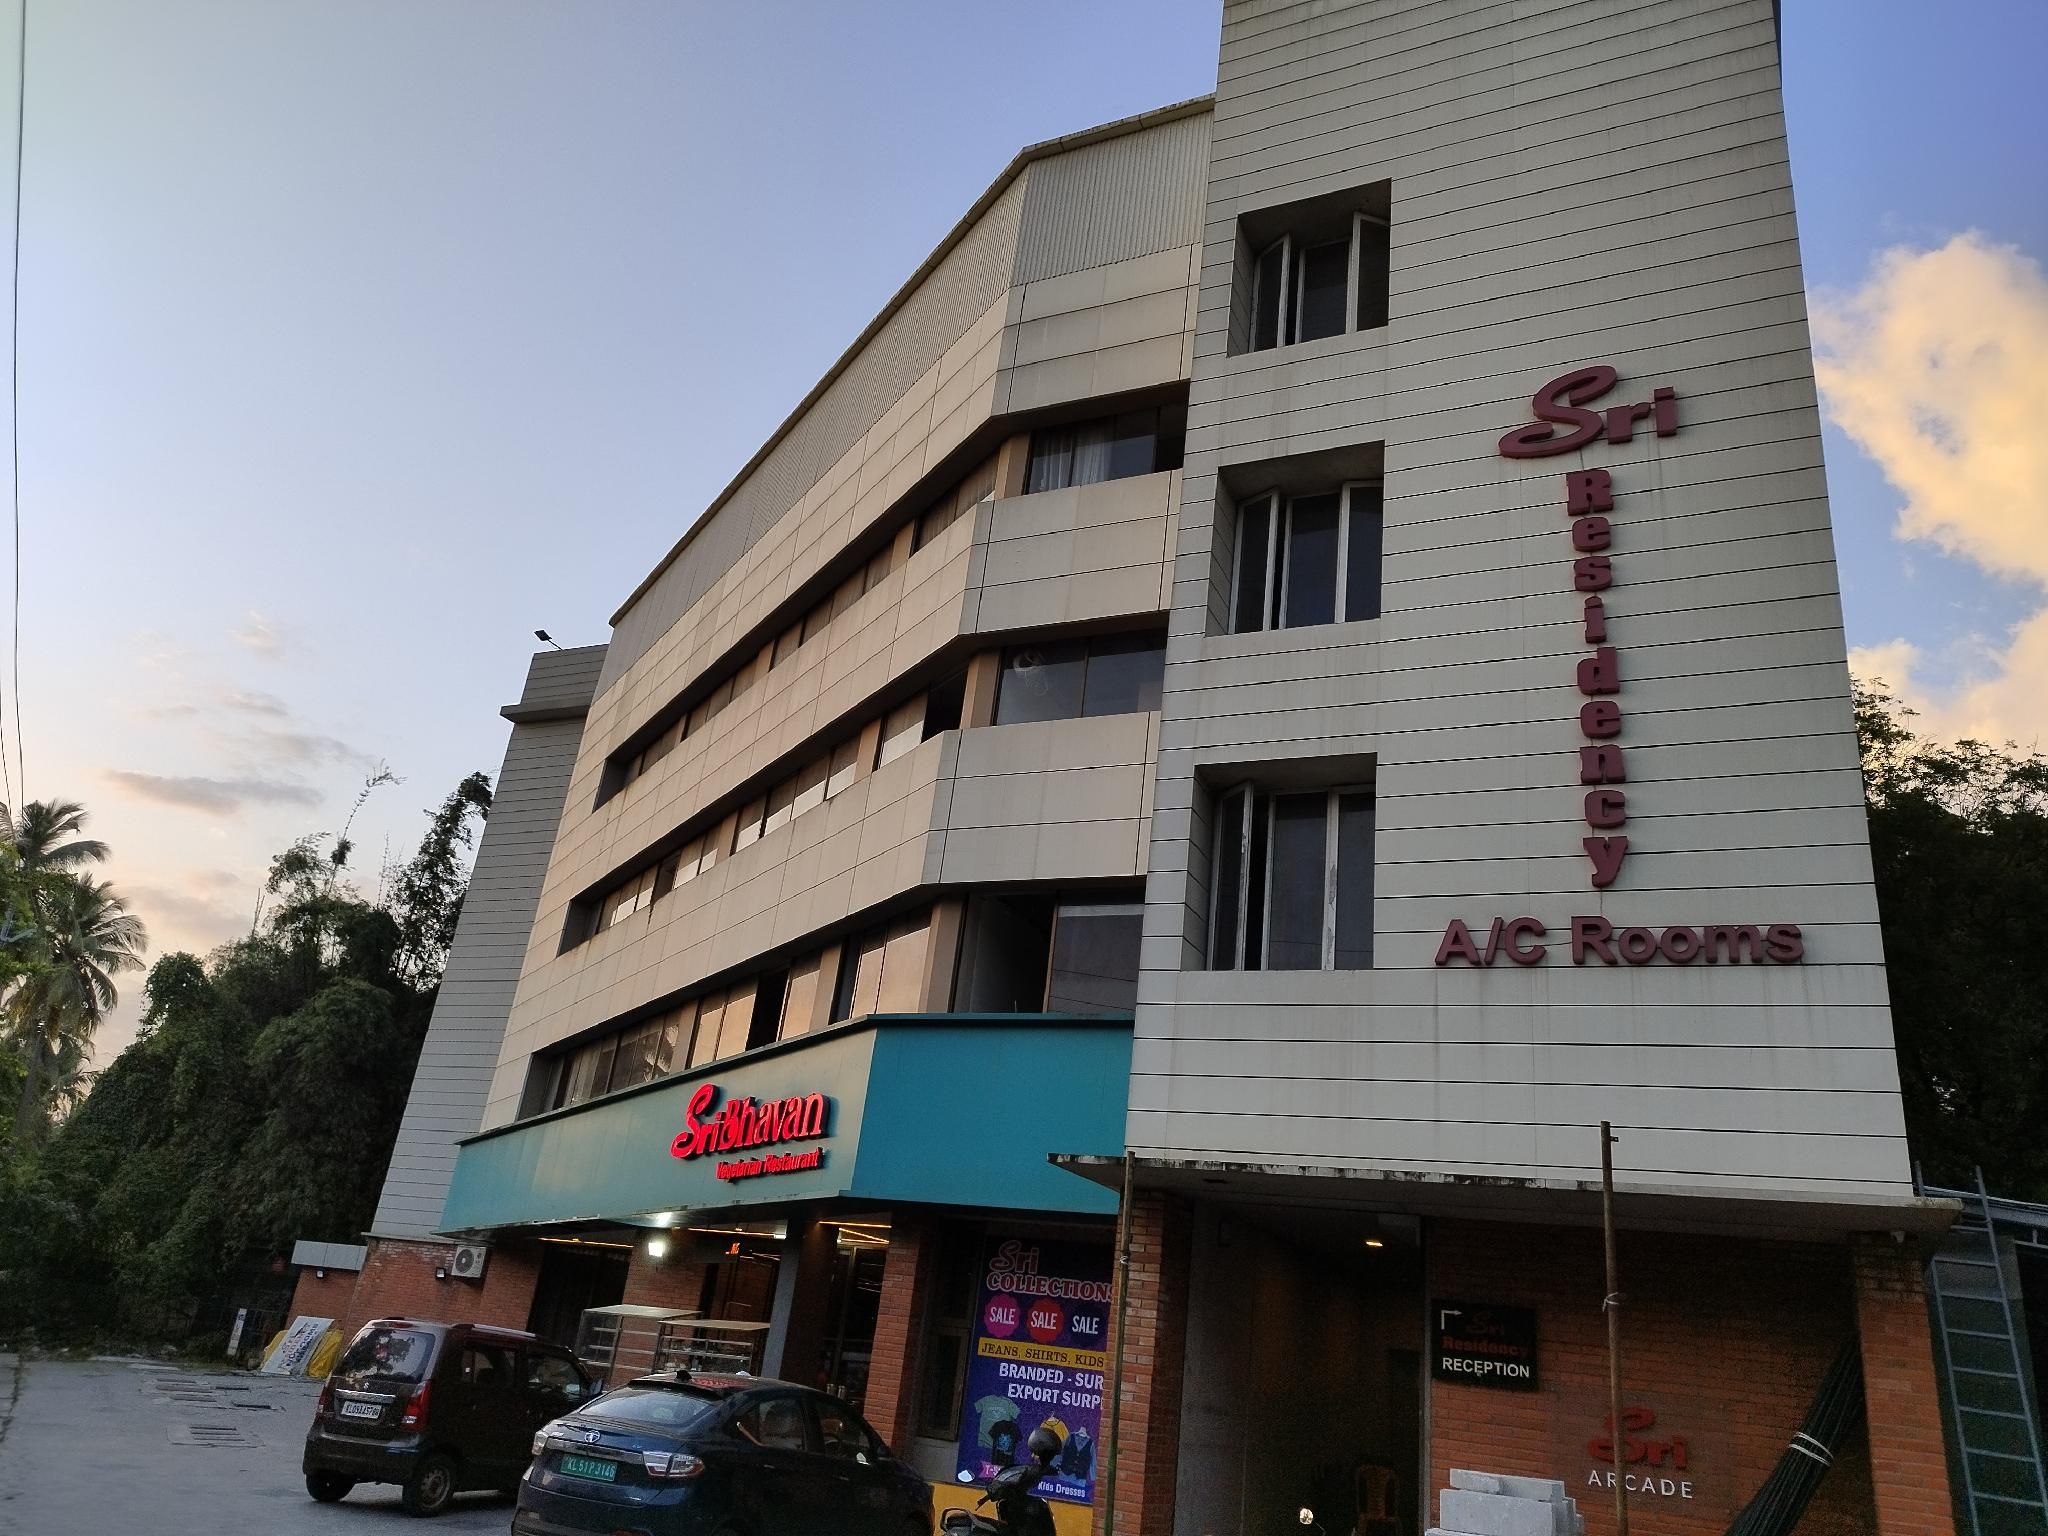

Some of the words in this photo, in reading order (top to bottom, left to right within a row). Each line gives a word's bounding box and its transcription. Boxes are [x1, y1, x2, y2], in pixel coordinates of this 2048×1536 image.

[1498, 365, 1678, 458] Sri
[1566, 470, 1628, 888] Residency
[1435, 917, 1546, 966] A/C
[1572, 916, 1804, 966] Rooms
[764, 1148, 824, 1173] Restaurant
[989, 1240, 1039, 1274] Sri
[989, 1307, 1016, 1325] SALE
[1030, 1311, 1058, 1330] SALE
[1072, 1315, 1100, 1335] SALE
[981, 1342, 1021, 1358] JEANS,
[1025, 1348, 1071, 1364] SHIRTS,
[1075, 1355, 1104, 1367] KIDS
[1000, 1362, 1064, 1384] BRANDED
[1442, 1357, 1530, 1378] RECEPTION
[1008, 1383, 1060, 1404] EXPORT
[1062, 1390, 1103, 1409] SURP
[1588, 1470, 1692, 1499] ARCADE
